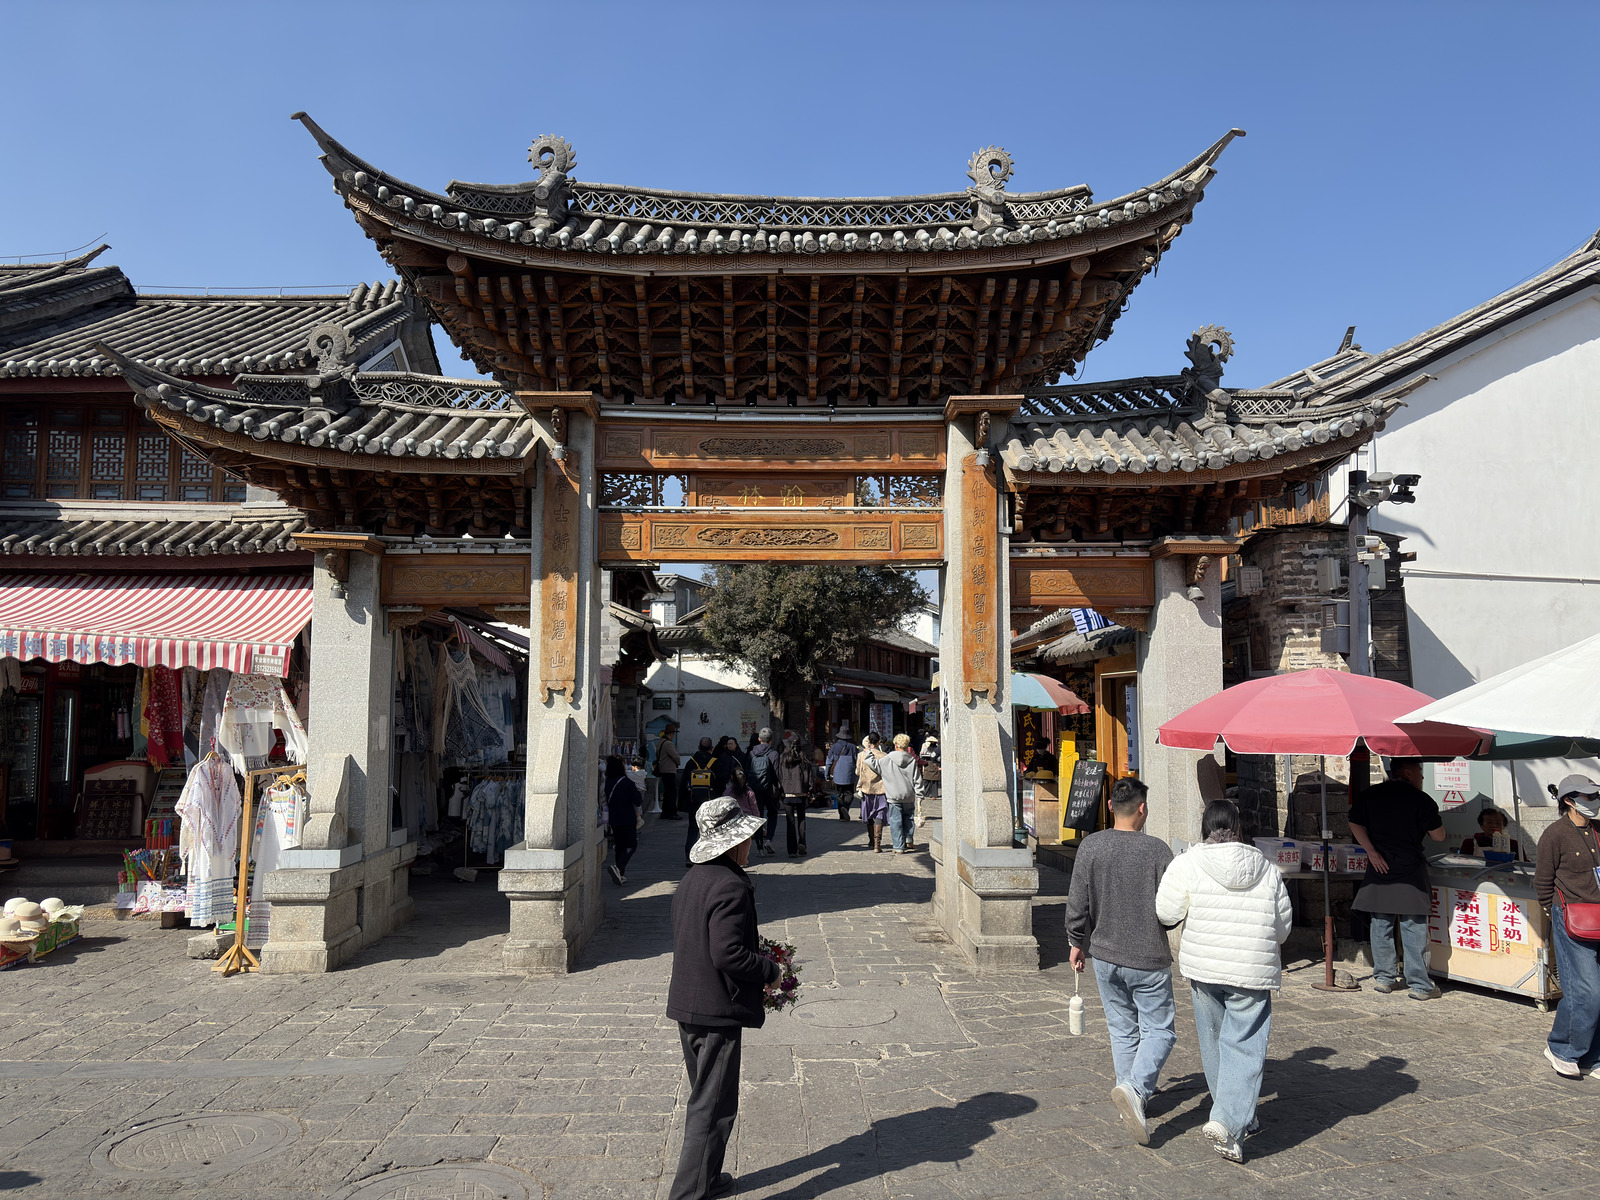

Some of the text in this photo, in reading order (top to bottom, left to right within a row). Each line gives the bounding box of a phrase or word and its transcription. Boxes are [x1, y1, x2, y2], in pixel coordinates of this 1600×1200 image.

[0, 635, 137, 660] 棒烟酒水饮料
[1277, 851, 1300, 863] 米凉虾
[1455, 889, 1482, 949] 喜洲老冰棒
[1503, 901, 1522, 941] 冰牛奶
